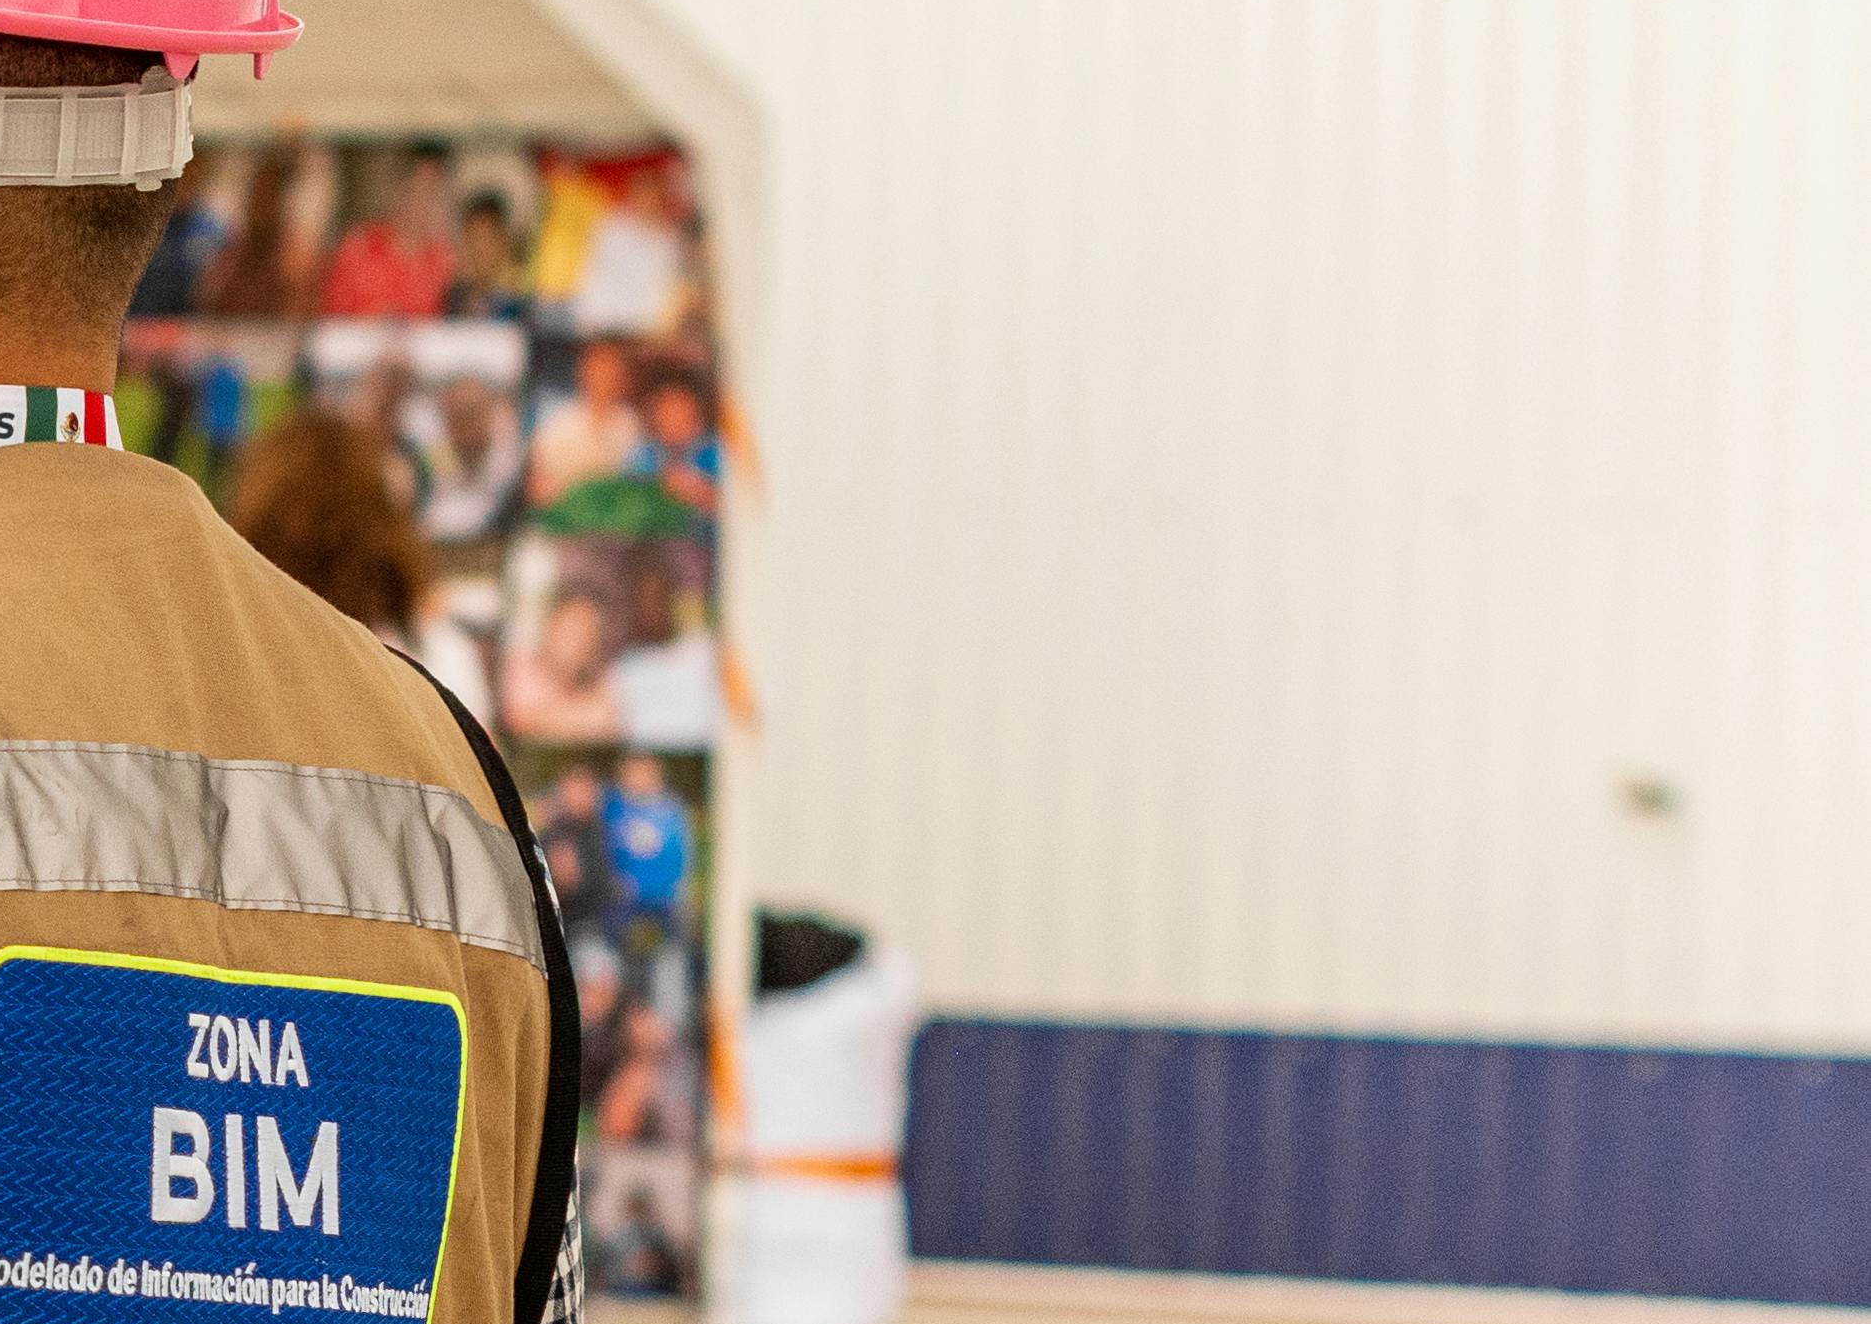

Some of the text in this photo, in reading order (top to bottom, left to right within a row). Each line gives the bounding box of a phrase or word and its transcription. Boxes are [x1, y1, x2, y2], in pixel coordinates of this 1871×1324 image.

[187, 1013, 309, 1088] ZONA
[151, 1105, 340, 1236] BIM
[107, 1258, 137, 1296] de
[141, 1259, 269, 1306] Información
[272, 1278, 320, 1315] para
[322, 1274, 340, 1310] la
[340, 1274, 429, 1319] Construcción
